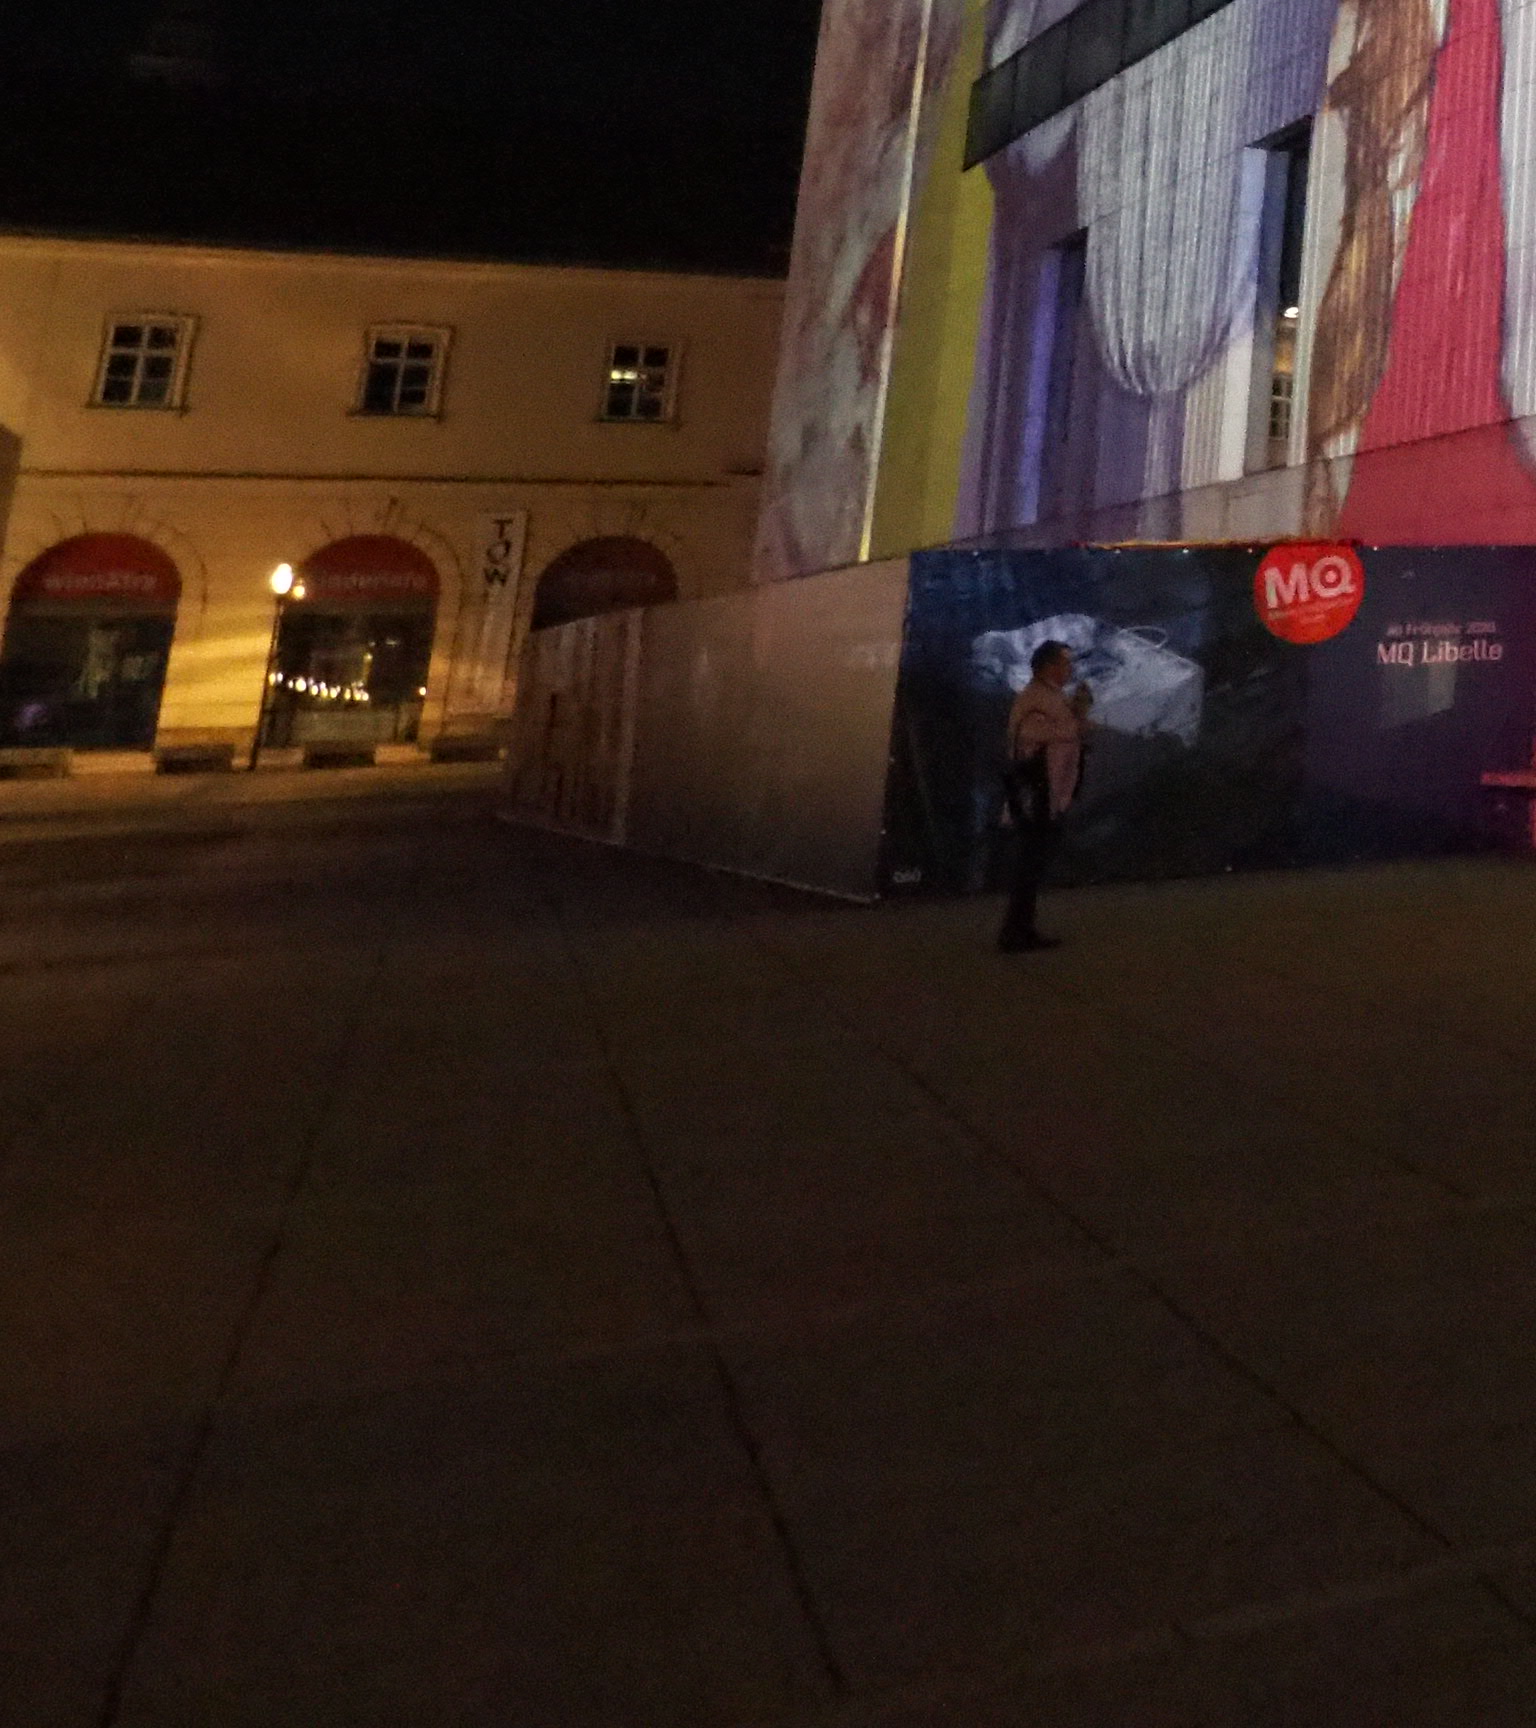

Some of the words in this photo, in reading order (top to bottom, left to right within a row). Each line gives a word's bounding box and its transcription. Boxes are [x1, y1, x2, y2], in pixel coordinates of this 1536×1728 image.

[1264, 555, 1357, 609] MQ
[1377, 641, 1414, 667] MQ
[1422, 638, 1503, 664] Libelle
